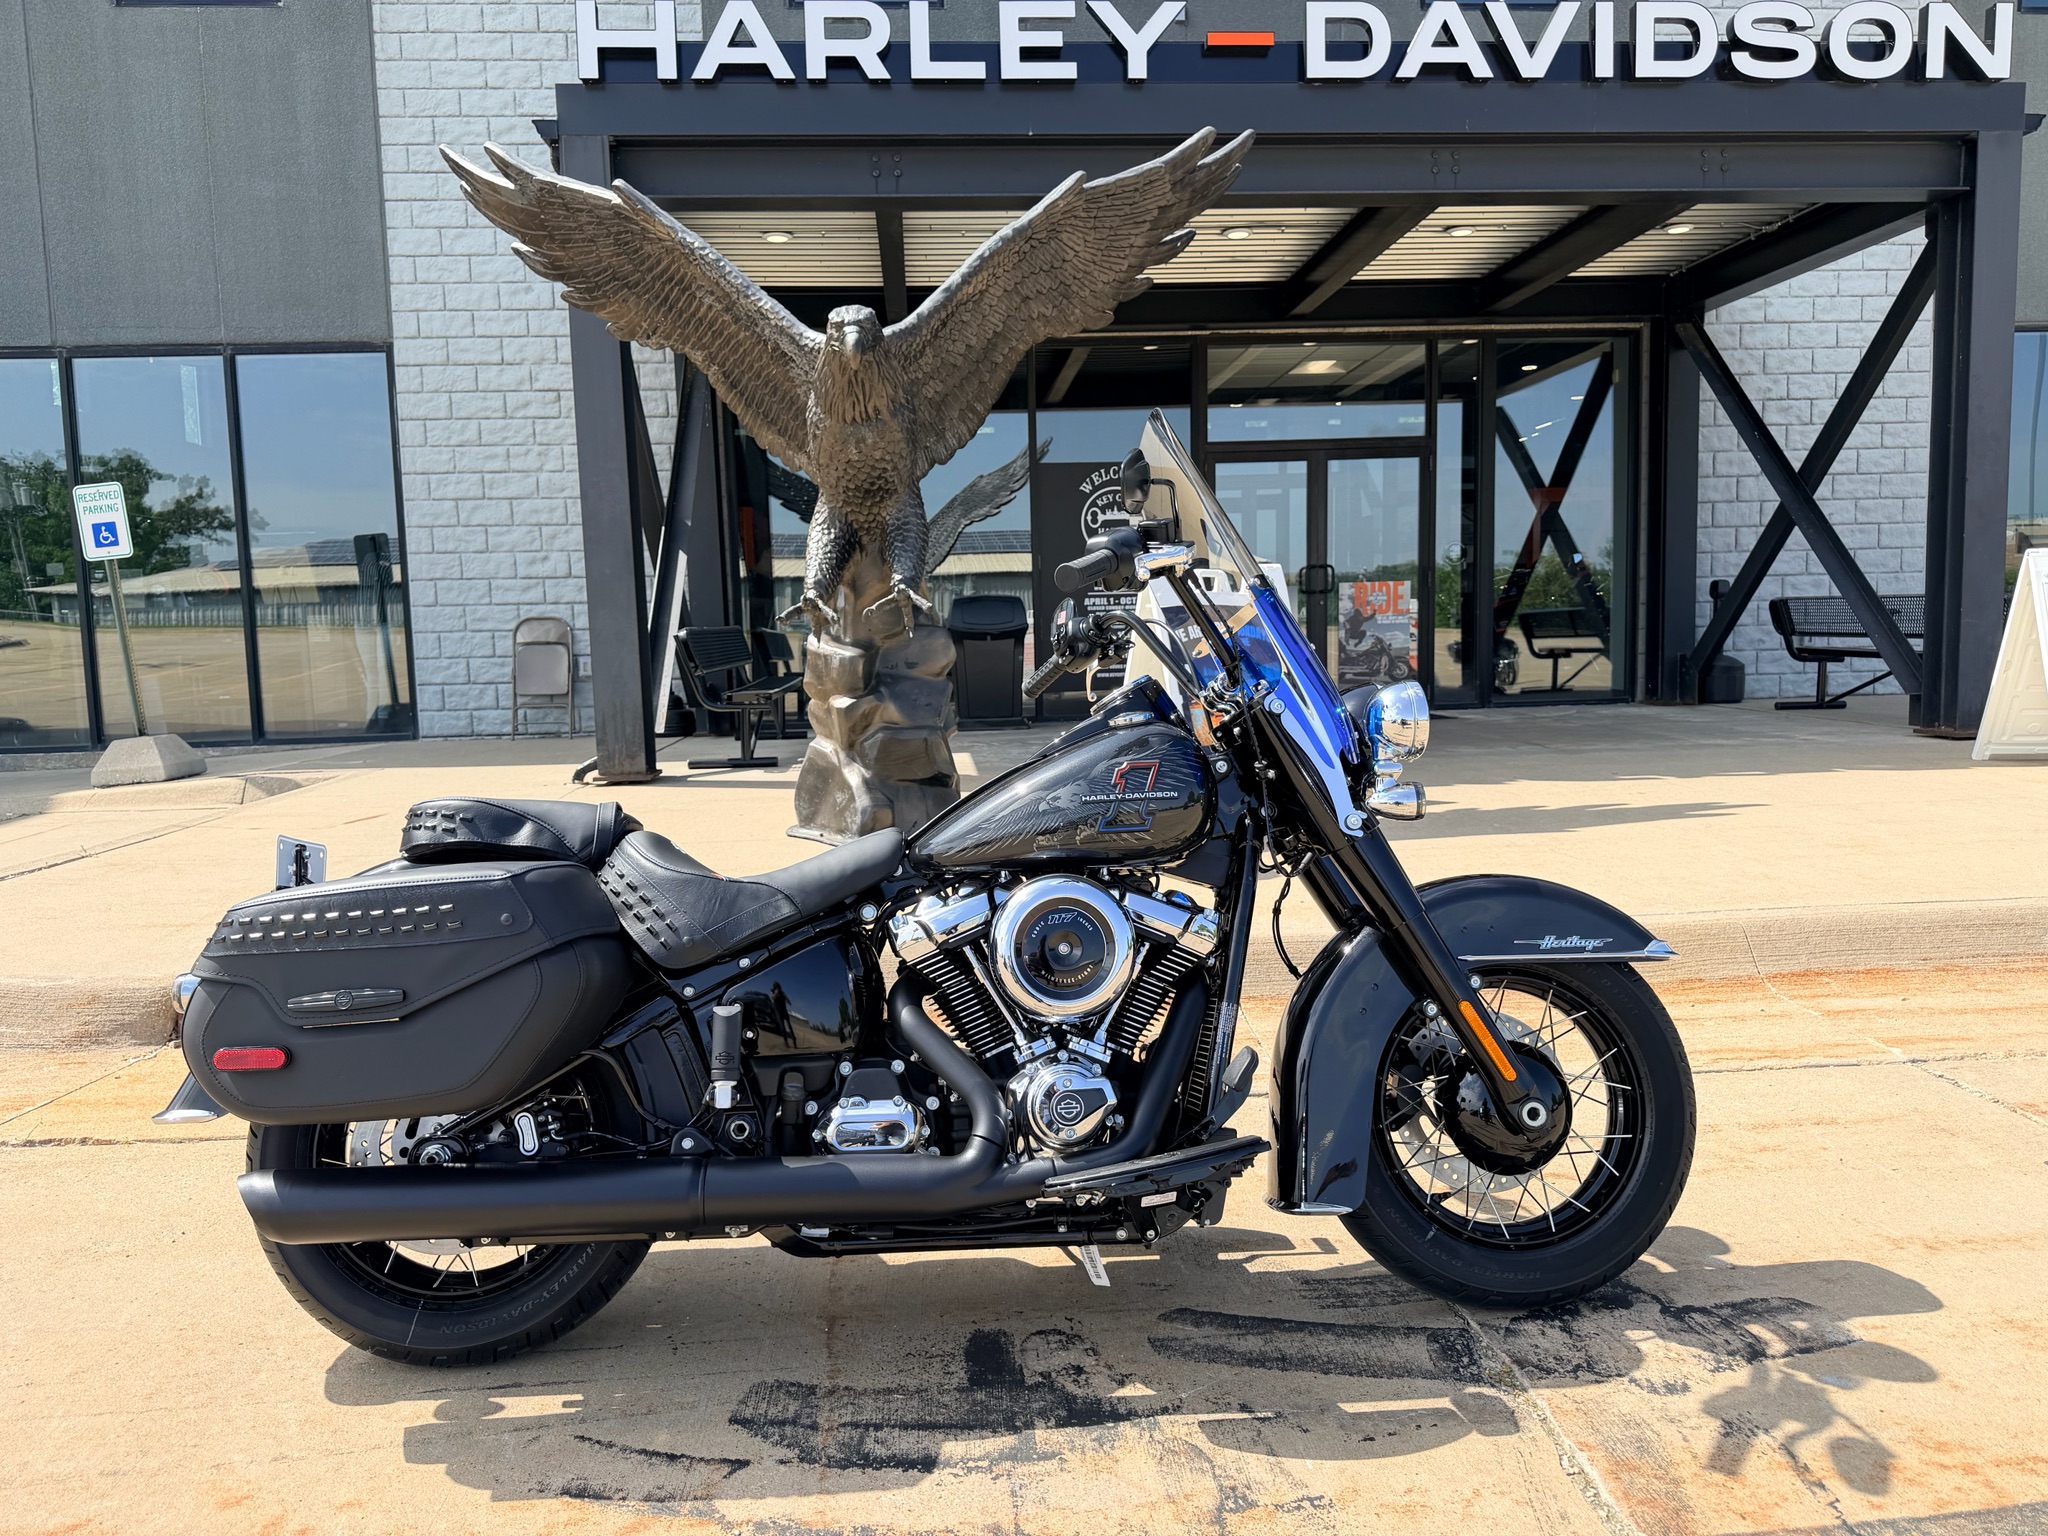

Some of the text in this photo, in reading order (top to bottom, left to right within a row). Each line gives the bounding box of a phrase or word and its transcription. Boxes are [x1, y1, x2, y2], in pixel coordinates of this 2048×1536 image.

[1079, 466, 1121, 494] WELC
[78, 490, 119, 503] RESERVED
[1096, 493, 1114, 507] KEY
[83, 503, 119, 515] PARKING
[1084, 597, 1108, 605] APRIL
[1109, 597, 1115, 605] 1
[1081, 791, 1178, 801] HARLEY-DAVIDSON
[1047, 912, 1078, 924] 117
[1540, 935, 1604, 950] Heritage
